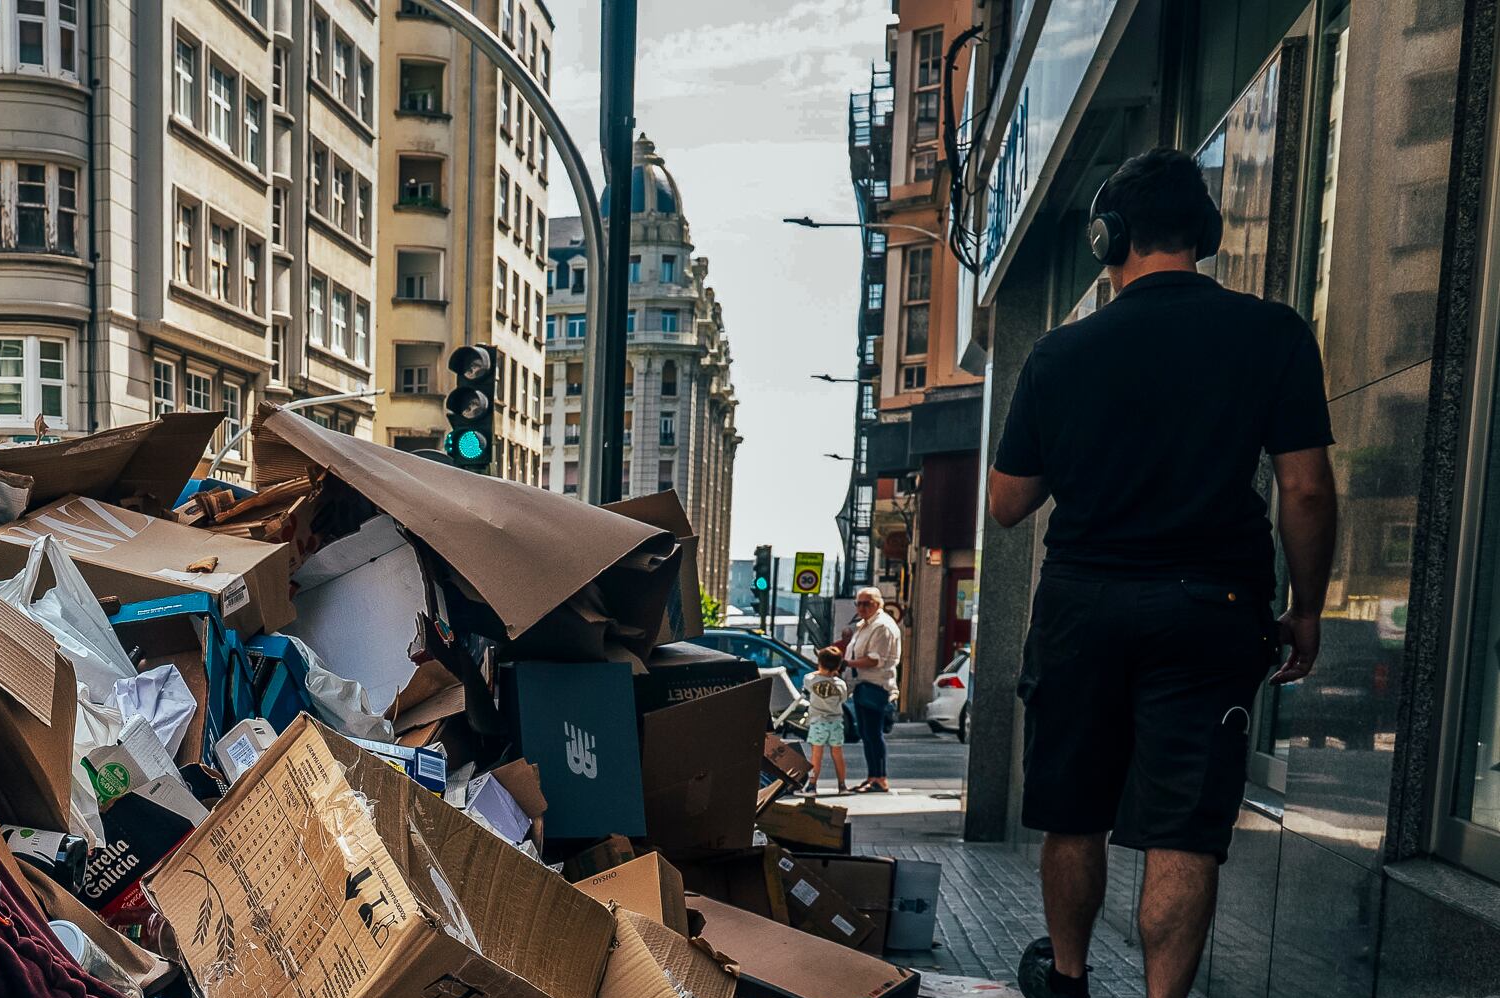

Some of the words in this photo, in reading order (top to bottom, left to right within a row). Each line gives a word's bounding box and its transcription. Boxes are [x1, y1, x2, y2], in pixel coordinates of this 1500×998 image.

[84, 839, 130, 886] strella
[84, 853, 140, 899] Galicia
[592, 871, 617, 886] OYSHO
